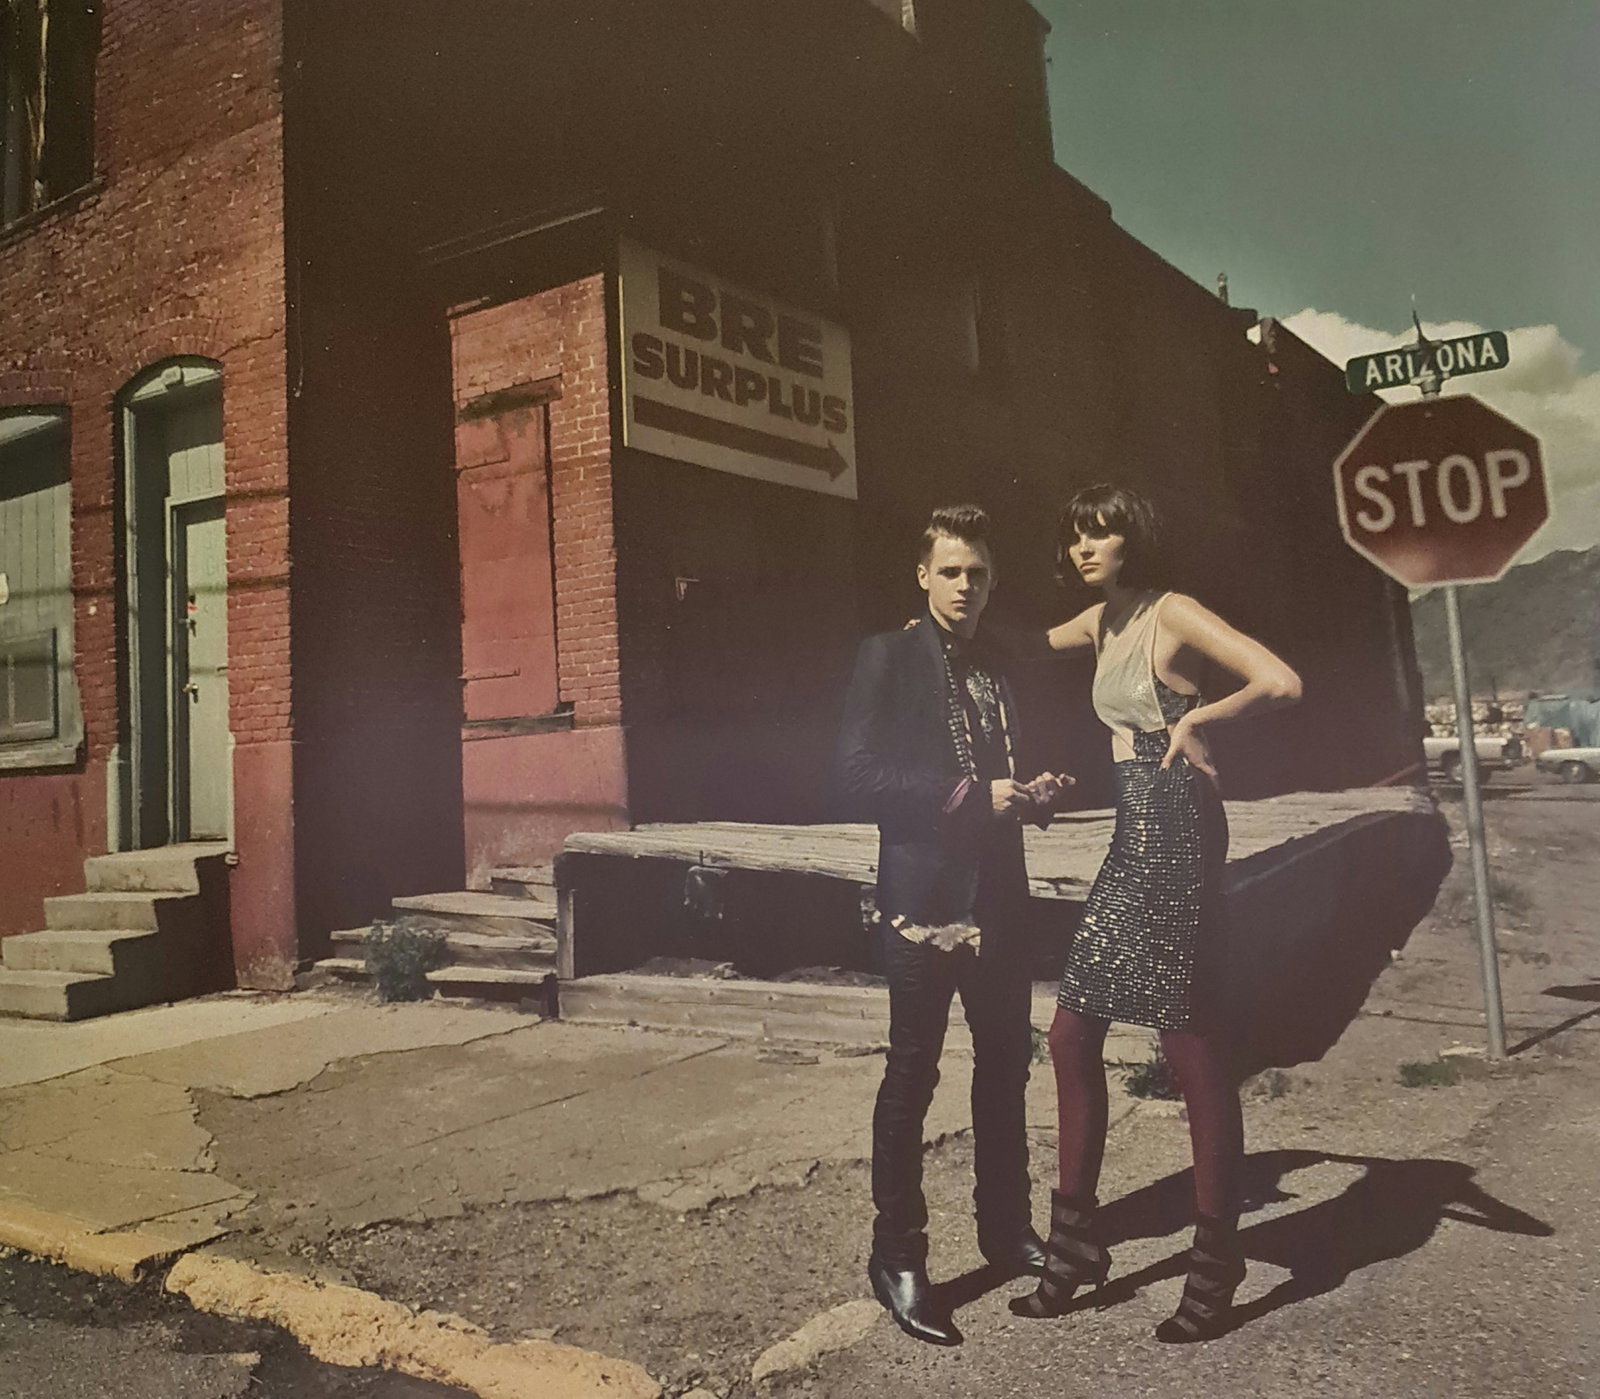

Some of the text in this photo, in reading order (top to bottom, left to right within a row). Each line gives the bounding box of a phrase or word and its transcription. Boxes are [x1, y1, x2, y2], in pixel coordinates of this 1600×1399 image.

[657, 265, 824, 380] BRE
[1365, 336, 1500, 387] ARIZONA
[631, 331, 848, 435] SURPLUS
[1354, 449, 1531, 533] STOP
